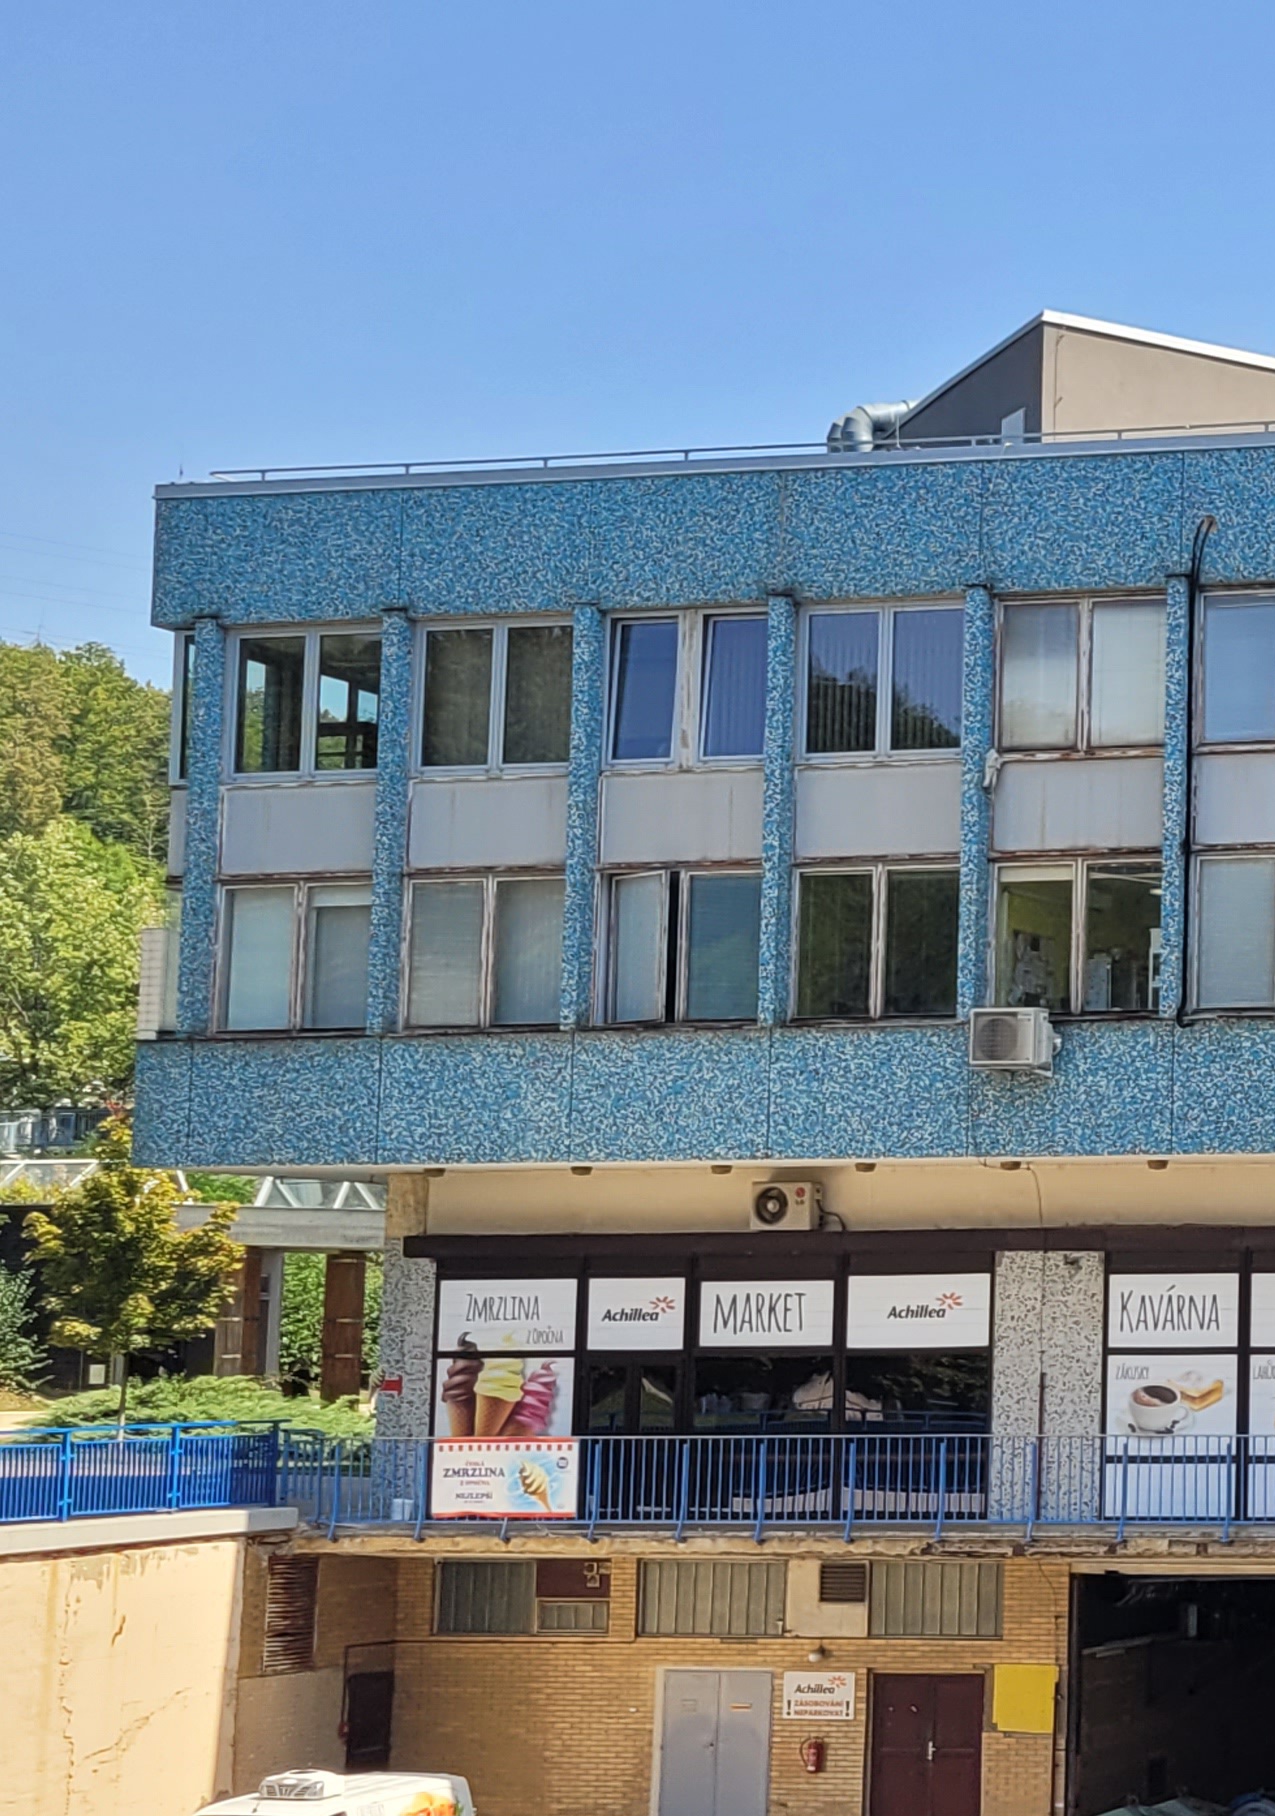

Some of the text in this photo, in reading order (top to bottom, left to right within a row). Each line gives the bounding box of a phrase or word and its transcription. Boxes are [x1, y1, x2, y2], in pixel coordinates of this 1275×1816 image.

[465, 1293, 540, 1323] ZMRZLINA
[601, 1308, 660, 1323] Achillea
[713, 1292, 807, 1335] MARKET
[887, 1304, 946, 1320] Achillea
[1119, 1284, 1220, 1333] KAVÁRNA
[533, 1326, 564, 1345] OPOČNA
[1115, 1361, 1149, 1381] ZÁKUSKY
[443, 1467, 506, 1478] ZMRZLINA
[794, 1684, 836, 1694] Achillea
